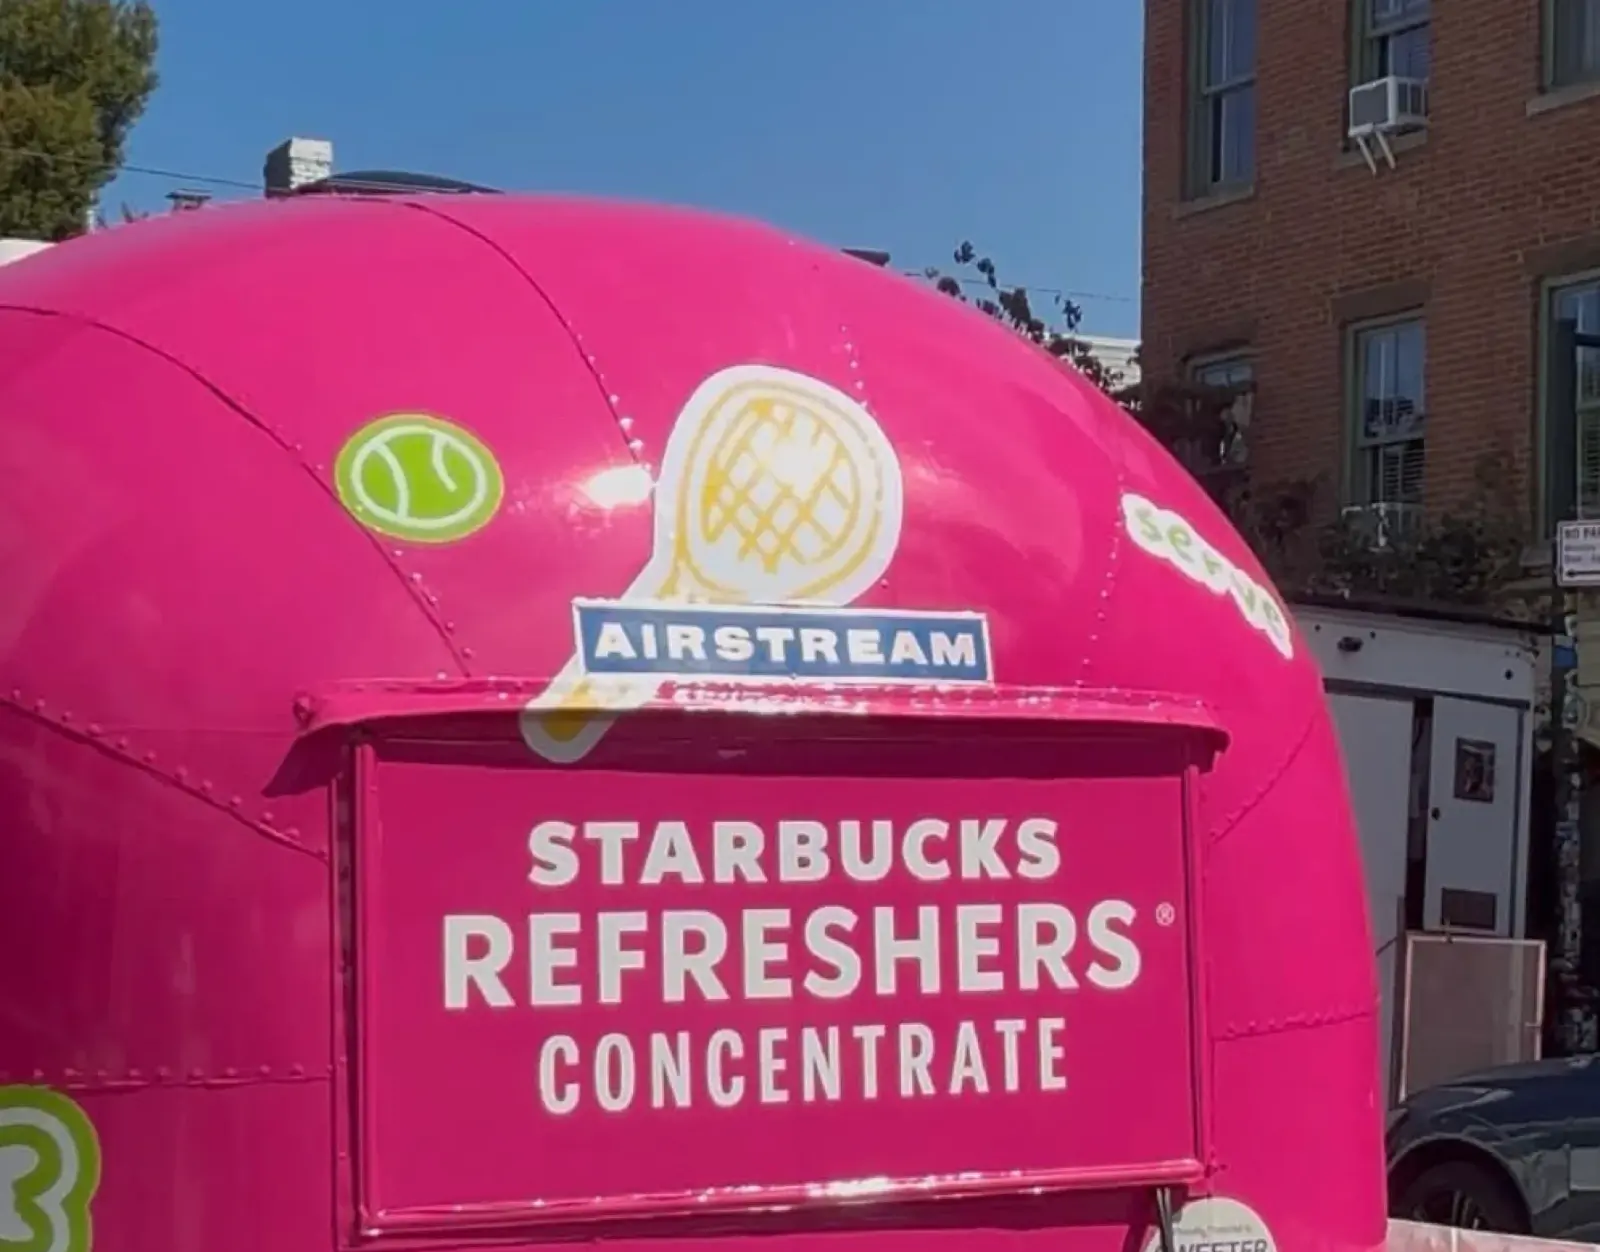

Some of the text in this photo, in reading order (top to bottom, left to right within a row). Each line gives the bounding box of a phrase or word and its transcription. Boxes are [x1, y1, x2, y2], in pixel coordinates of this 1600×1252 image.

[594, 621, 977, 667] AIRSTREAM
[527, 818, 1062, 886] STARBUCKS
[442, 899, 1143, 1010] REFRESHERS
[538, 1017, 1068, 1115] CONCENTRATE
